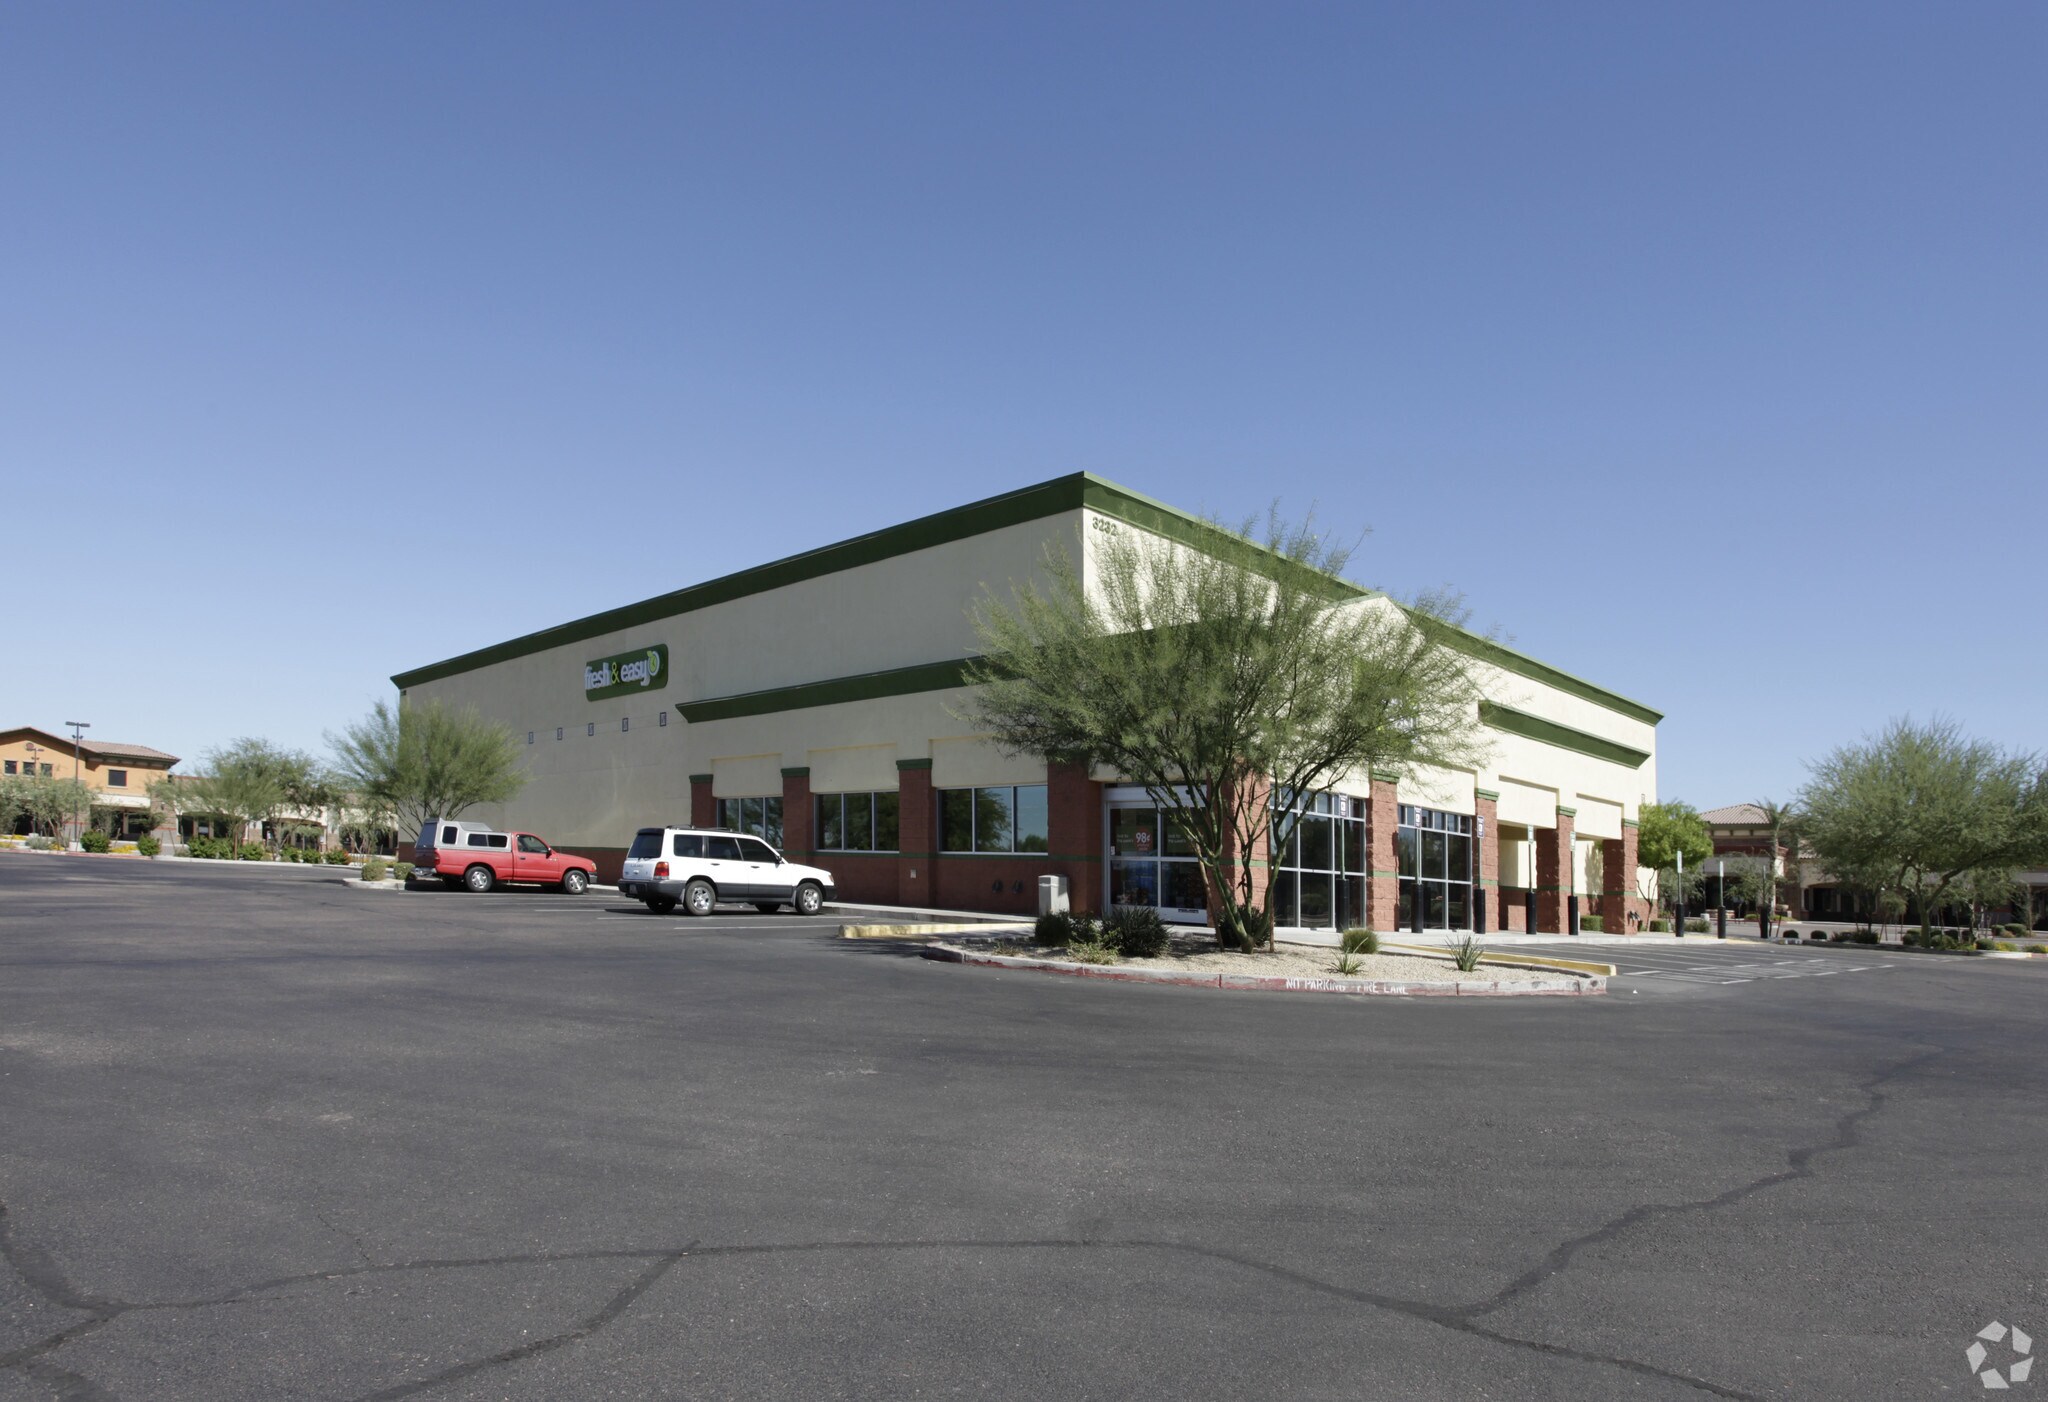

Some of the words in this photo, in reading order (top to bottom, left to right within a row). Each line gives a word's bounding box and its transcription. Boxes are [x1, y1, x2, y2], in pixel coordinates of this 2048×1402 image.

[584, 662, 612, 690] fresh
[611, 662, 620, 684] &
[620, 659, 650, 686] easy
[1286, 978, 1300, 989] NO
[1383, 984, 1409, 995] LANE
